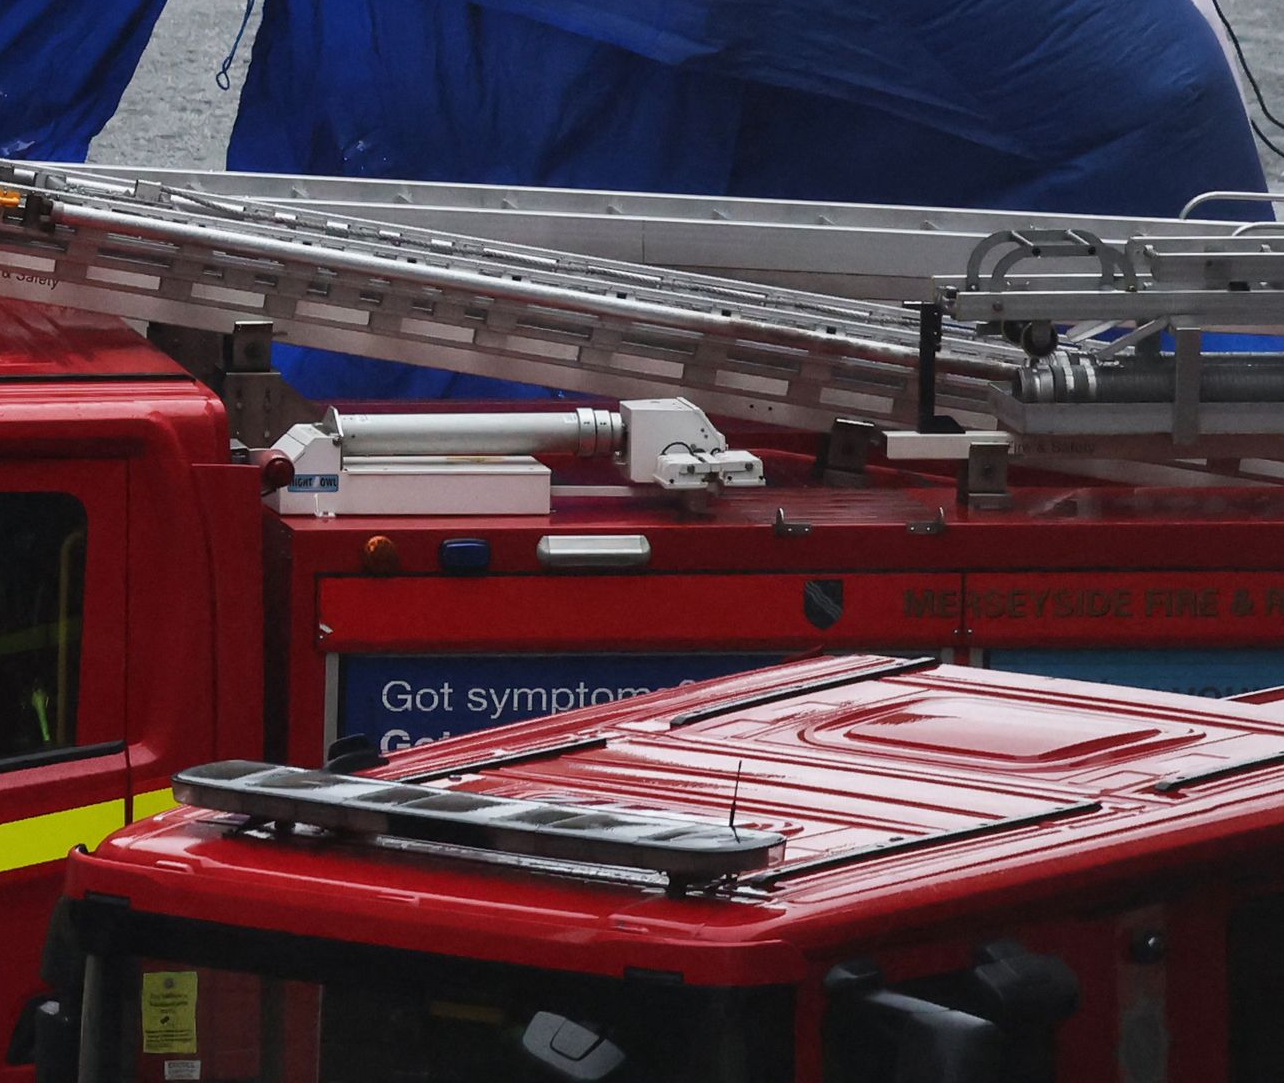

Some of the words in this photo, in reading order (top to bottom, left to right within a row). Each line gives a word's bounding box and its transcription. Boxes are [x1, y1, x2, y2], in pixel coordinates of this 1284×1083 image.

[903, 588, 1132, 617] MERSEYSIDE
[1144, 588, 1219, 617] FIRE
[1231, 589, 1255, 616] &
[382, 681, 453, 712] Got
